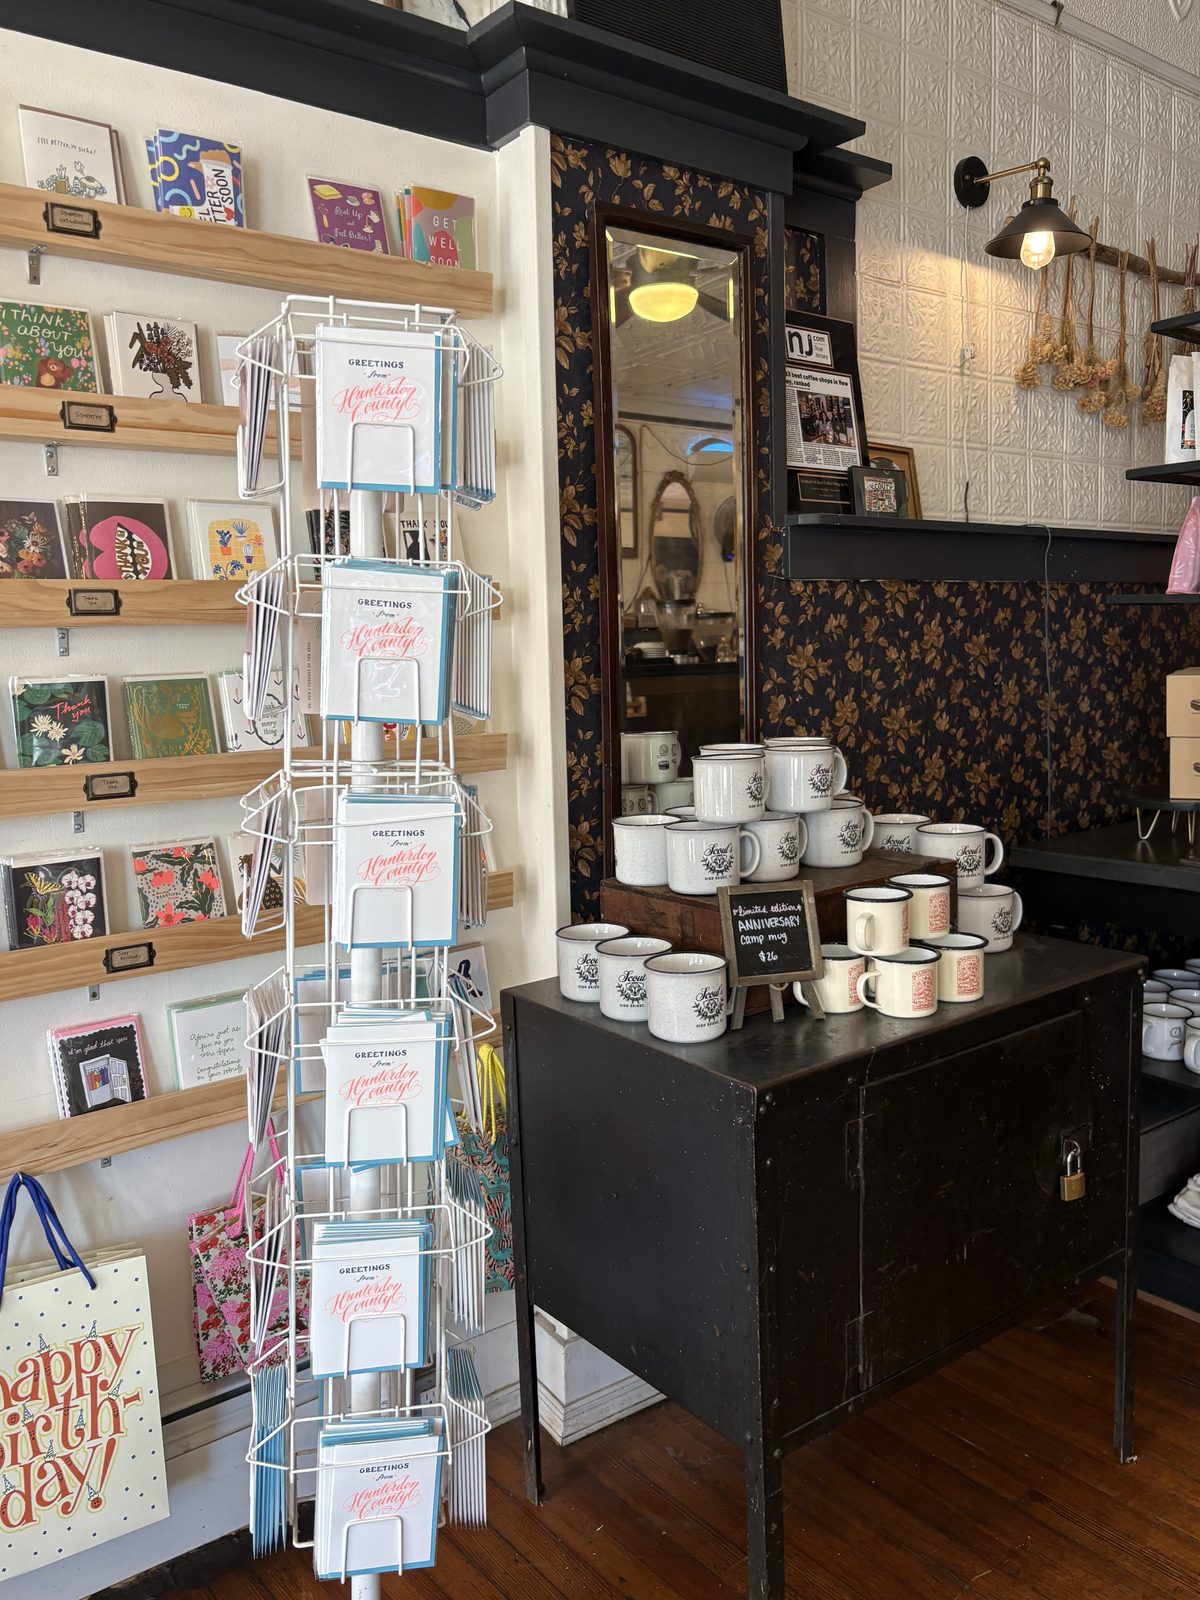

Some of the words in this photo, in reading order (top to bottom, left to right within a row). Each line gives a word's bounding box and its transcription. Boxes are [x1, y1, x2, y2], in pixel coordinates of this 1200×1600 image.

[212, 168, 234, 205] SOON
[334, 206, 351, 218] Rest
[352, 208, 364, 221] Up
[432, 215, 458, 232] GET
[334, 228, 348, 238] Feel
[349, 228, 372, 242] Better!
[428, 234, 462, 252] WELL
[429, 255, 461, 269] SOON
[348, 358, 404, 369] GREETINGS
[367, 370, 388, 379] from
[803, 374, 818, 382] coffee
[794, 380, 810, 388] ranked
[332, 376, 417, 413] Hunterdon
[351, 393, 421, 422] County
[433, 520, 450, 528] OU
[357, 598, 412, 609] GREETINGS
[375, 610, 395, 618] from
[340, 617, 425, 651] Hunterdon
[358, 634, 428, 658] County
[50, 694, 92, 720] Thank
[72, 708, 92, 723] you
[372, 830, 426, 838] GREETINGS
[882, 834, 911, 845] Scout's
[704, 842, 733, 856] Scout's
[356, 843, 438, 881] Hunterdon
[374, 862, 441, 888] County
[738, 915, 800, 932] ANNIVERSARY
[768, 932, 788, 945] mug
[758, 950, 778, 963] $26
[216, 1025, 229, 1040] just
[84, 1041, 98, 1055] glad
[100, 1039, 114, 1049] that
[116, 1036, 128, 1044] you
[199, 1043, 213, 1052] fun
[223, 1038, 234, 1047] you
[354, 1050, 408, 1058] GREETINGS
[372, 1060, 391, 1068] from
[208, 1071, 222, 1081] your
[339, 1062, 419, 1100] Hunterdon
[357, 1080, 424, 1106] County
[339, 1264, 391, 1274] GREETINGS
[356, 1274, 376, 1282] from
[325, 1276, 403, 1315] Hunterdon
[342, 1292, 407, 1322] County
[0, 1372, 142, 1471] irth-
[359, 1462, 410, 1474] GREETINGS
[0, 1437, 117, 1528] day!
[376, 1474, 394, 1482] from
[343, 1474, 420, 1513] Hunterdon
[359, 1492, 424, 1520] County
